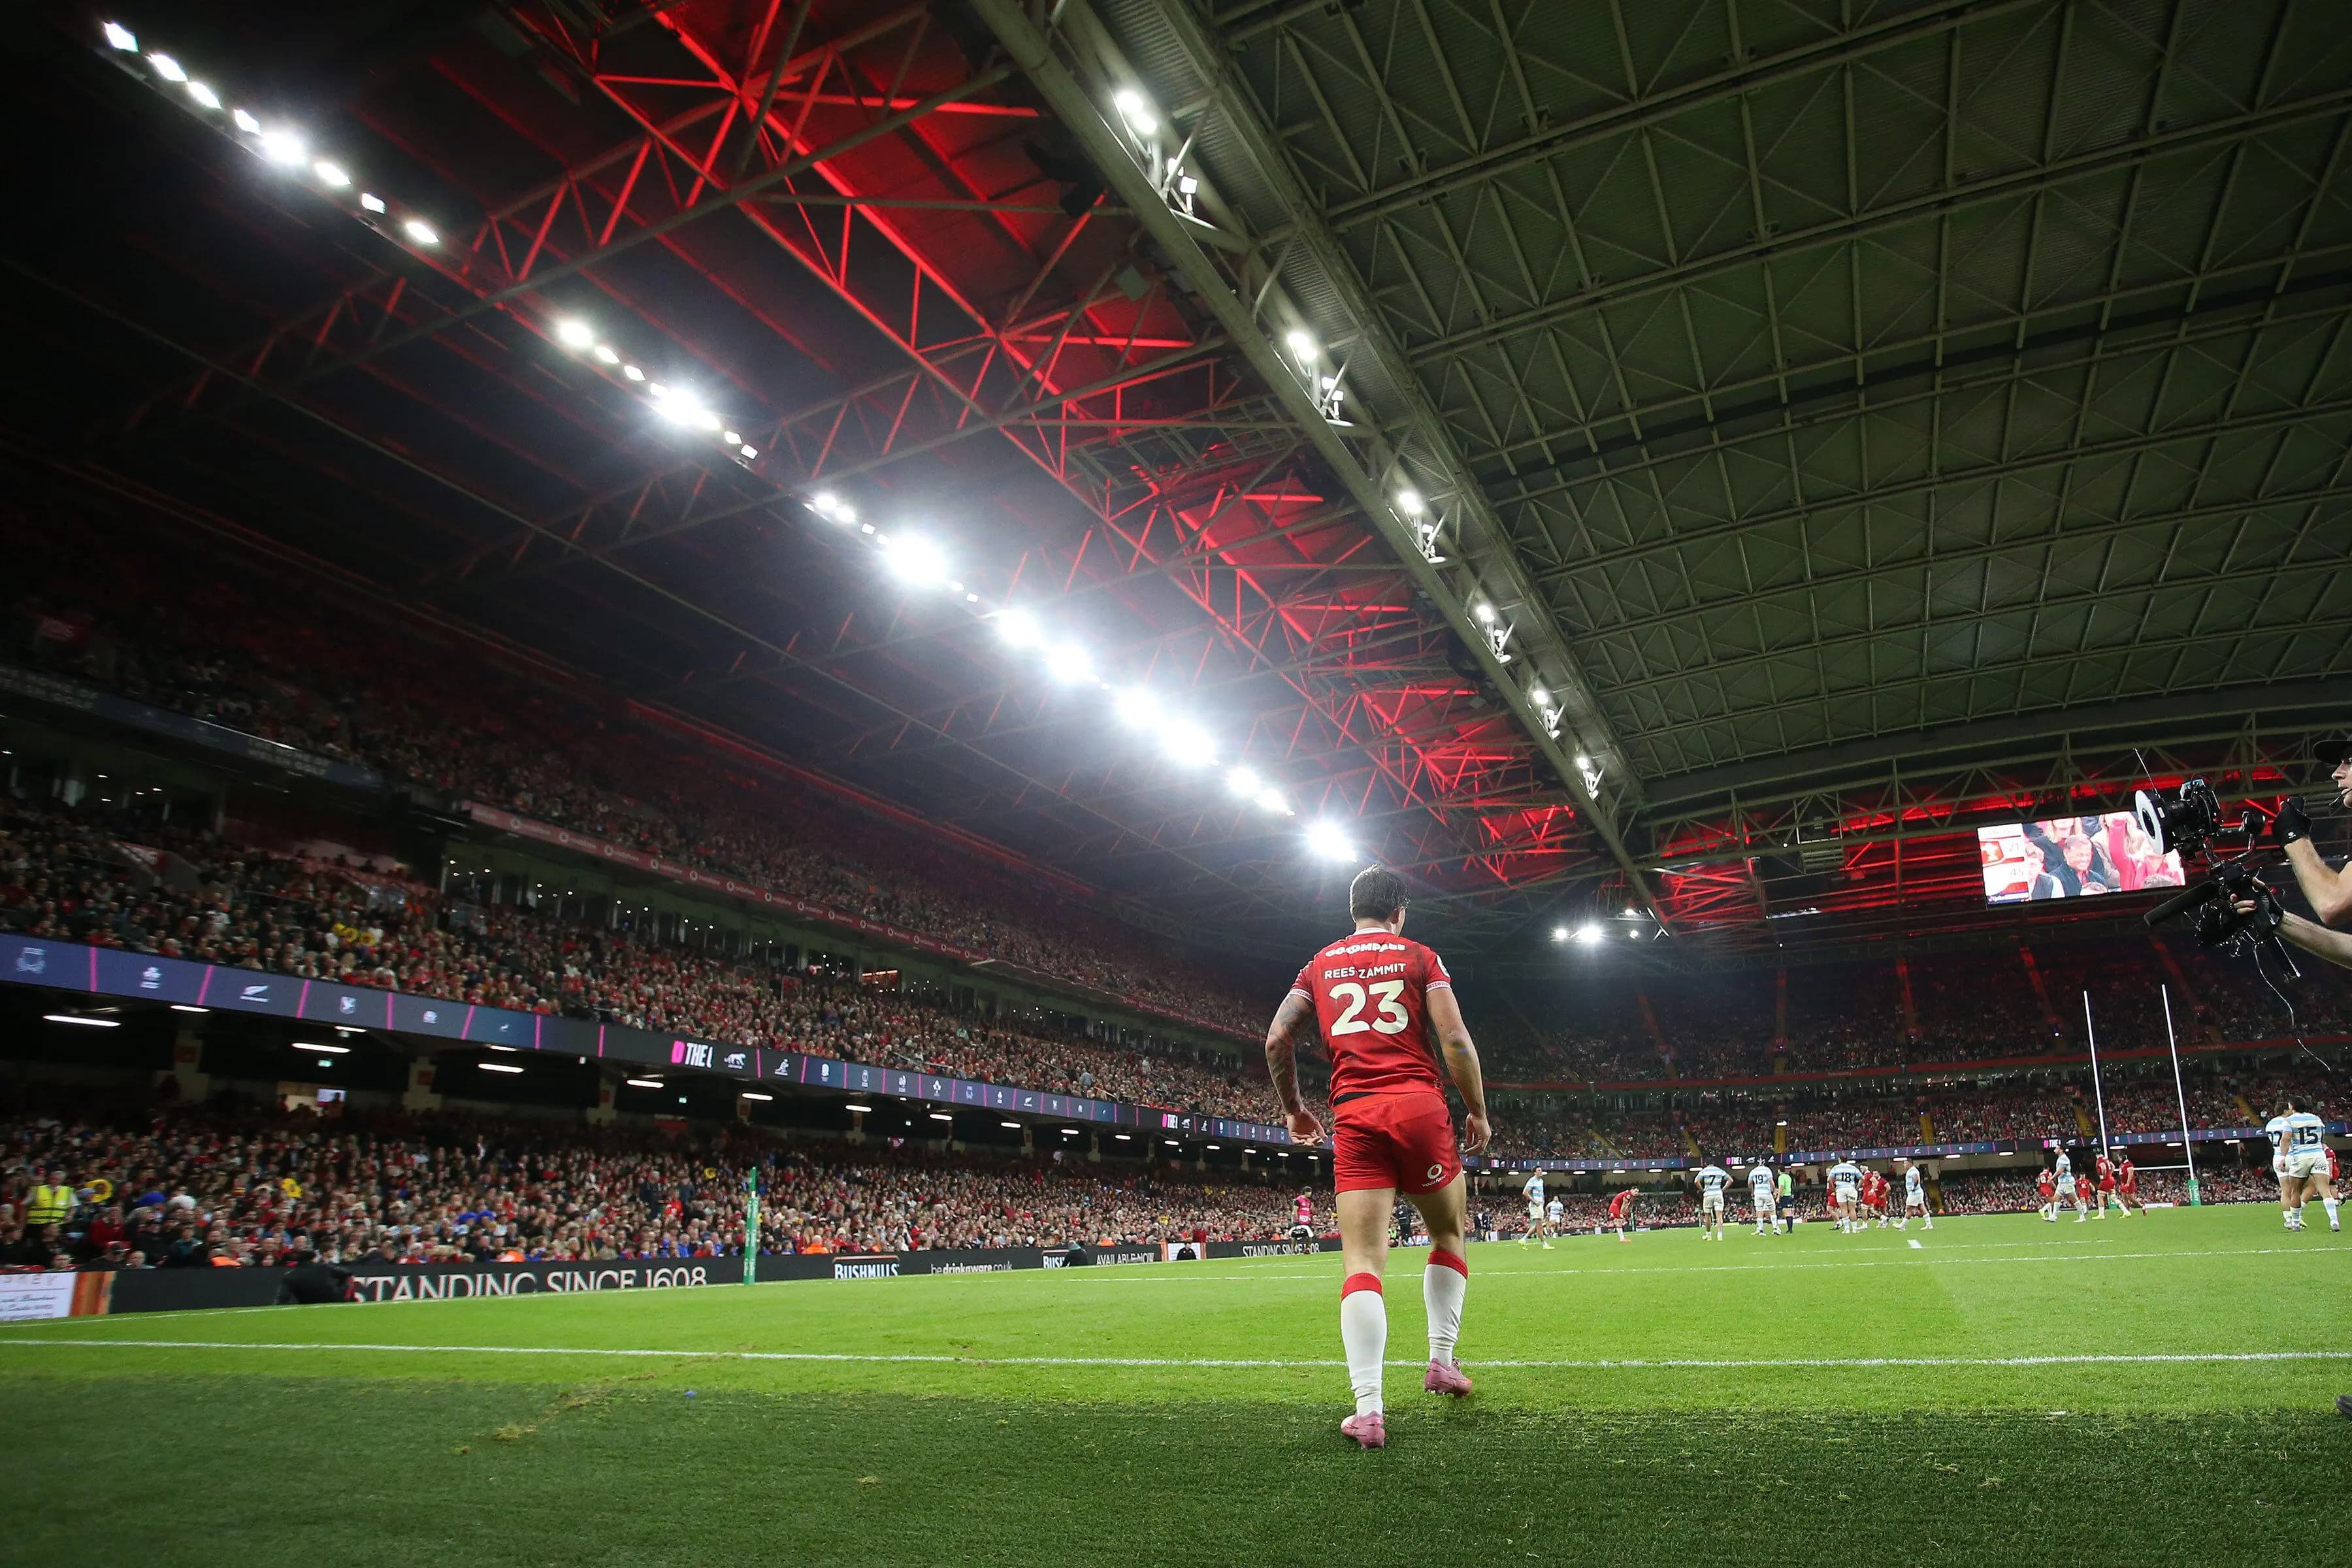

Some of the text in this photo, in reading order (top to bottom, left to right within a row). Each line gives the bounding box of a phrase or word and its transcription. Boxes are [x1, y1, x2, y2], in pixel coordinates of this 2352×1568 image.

[1329, 979, 1409, 1037] 23
[2298, 1126, 2319, 1145] 15
[1709, 1175, 1716, 1185] 7
[1755, 1175, 1763, 1184] 19
[1841, 1172, 1852, 1182] 18
[547, 1269, 637, 1293] SINCE
[645, 1266, 708, 1288] 1608
